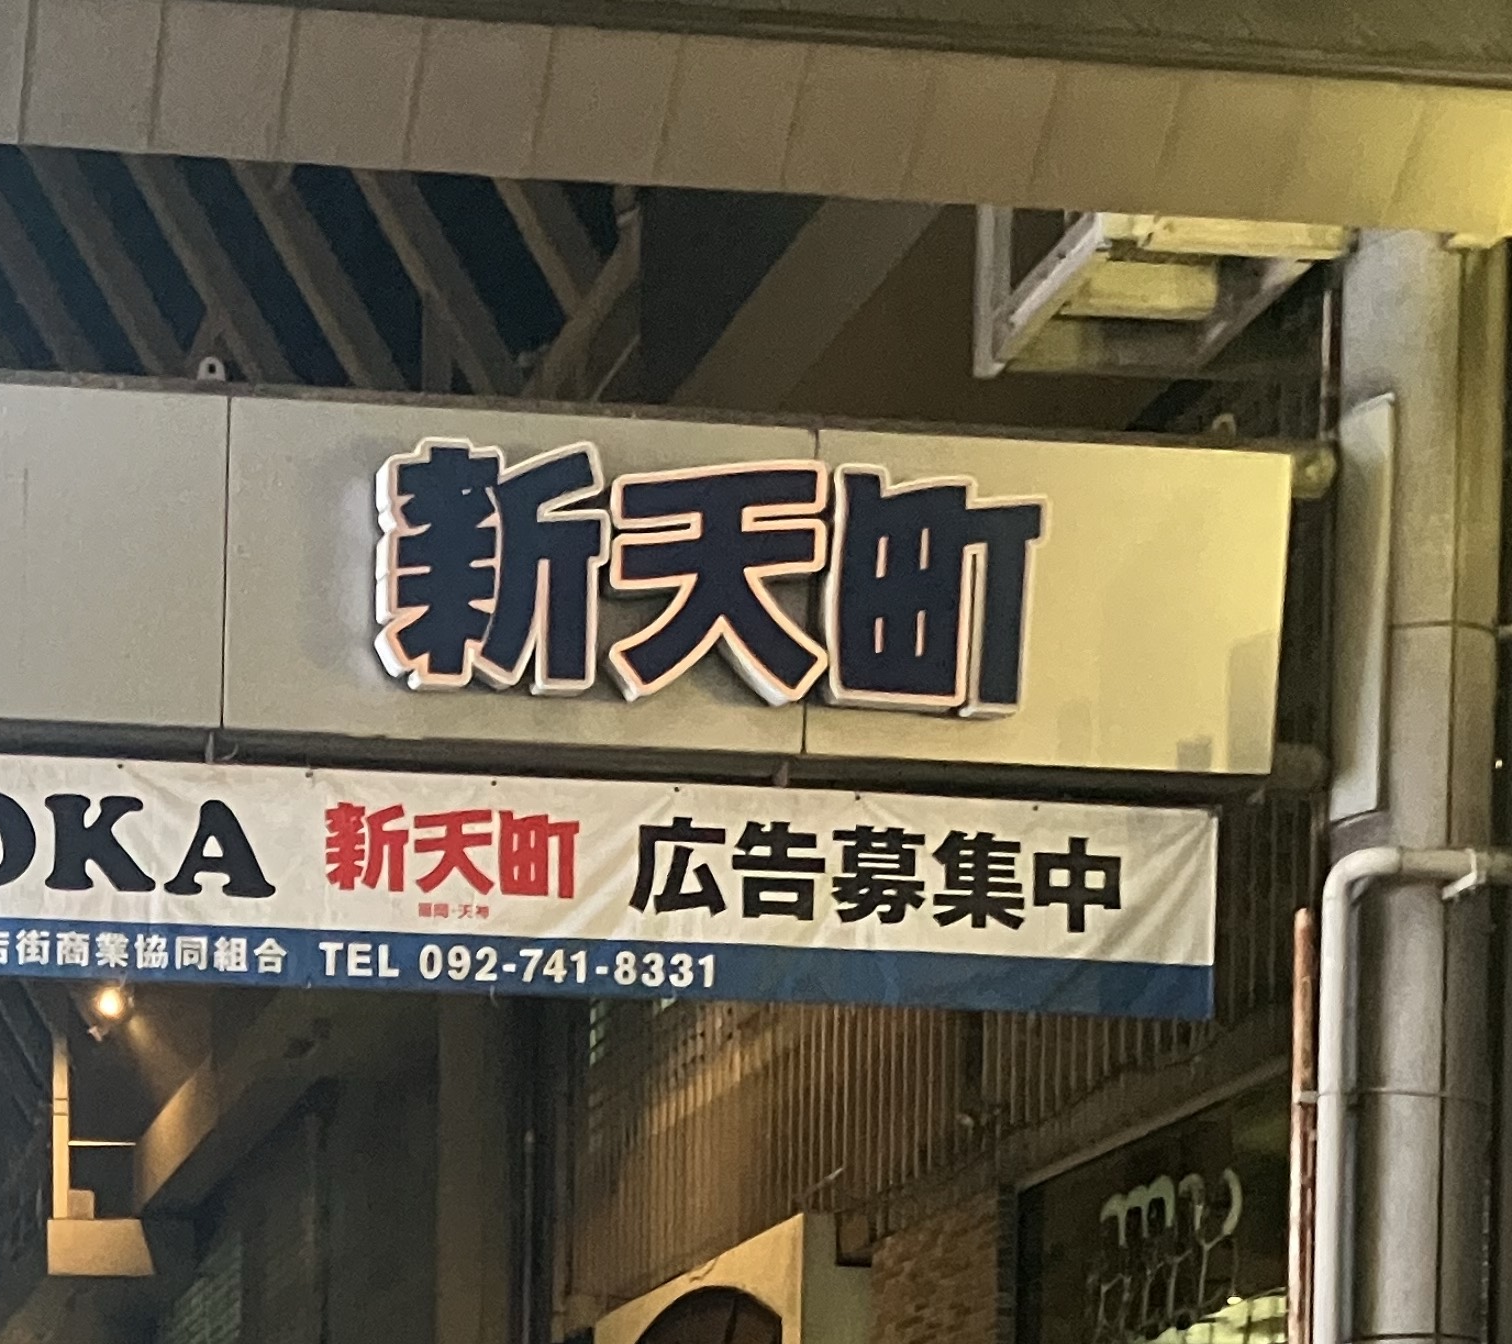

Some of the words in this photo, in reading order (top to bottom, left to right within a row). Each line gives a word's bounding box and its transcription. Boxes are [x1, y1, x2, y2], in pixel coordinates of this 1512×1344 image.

[376, 437, 1052, 718] 新天町
[325, 803, 580, 900] 新天町
[628, 816, 1123, 935] 広告募集中
[319, 941, 400, 980] TEL
[419, 943, 718, 989] 092-741-8331
